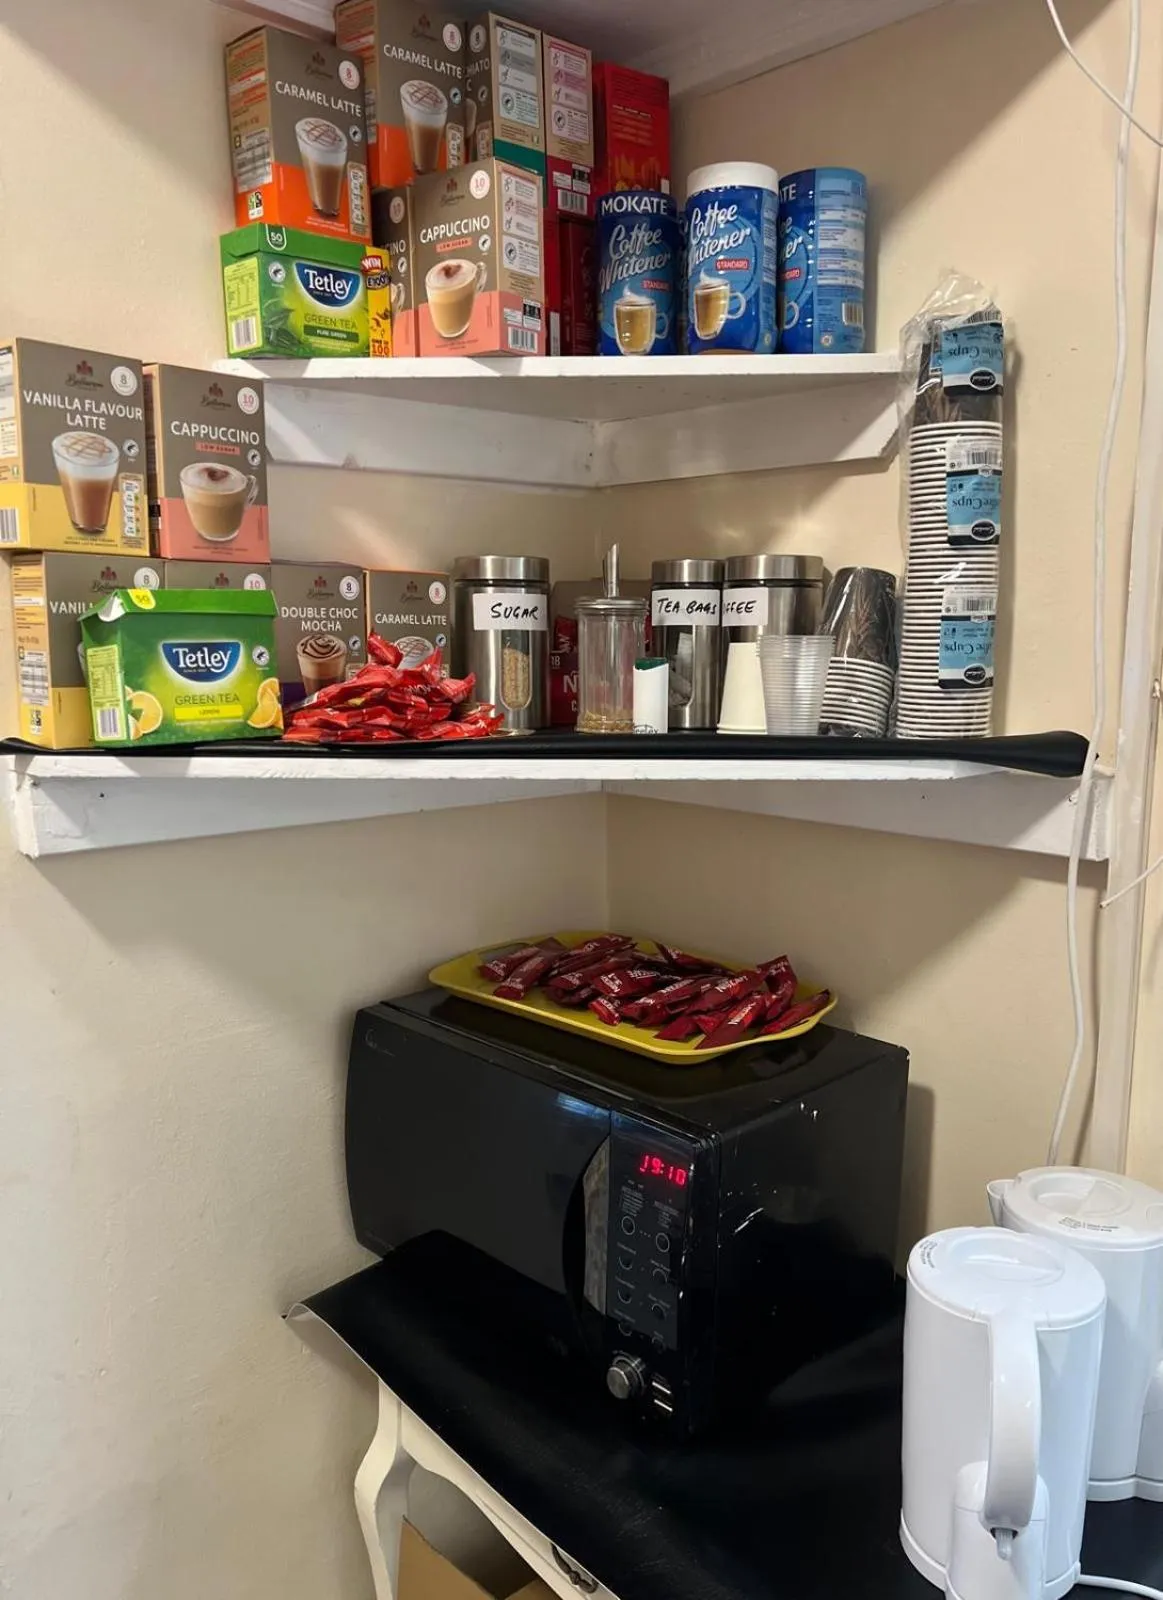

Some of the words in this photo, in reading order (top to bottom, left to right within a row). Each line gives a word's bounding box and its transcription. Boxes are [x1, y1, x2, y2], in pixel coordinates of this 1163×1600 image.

[383, 43, 433, 70] CARAMEL
[434, 59, 463, 79] LATTE
[275, 80, 329, 107] CARAMEL
[331, 97, 362, 118] LATTE
[474, 176, 486, 189] 10
[601, 195, 668, 216] MOKATE
[419, 214, 491, 244] CAPPUCCINO
[690, 200, 738, 245] Coffee
[270, 230, 283, 242] 50
[609, 223, 663, 260] Coffee
[361, 257, 382, 270] WIN
[599, 251, 671, 293] Whitener
[303, 268, 353, 300] Tetley
[303, 312, 337, 327] GREEN
[340, 318, 358, 331] TEA
[371, 343, 390, 354] 100
[947, 344, 981, 359] Cups
[120, 374, 127, 385] 8
[23, 389, 82, 411] VANILLA
[85, 399, 143, 421] FLAVOUR
[243, 393, 254, 405] 10
[66, 412, 107, 430] LATTE
[170, 420, 260, 446] CAPPUCCINO
[951, 495, 983, 510] Cups
[143, 574, 150, 585] 8
[50, 600, 94, 615] VANIL
[281, 606, 327, 619] DOUBLE
[329, 607, 359, 619] CHOC
[490, 602, 539, 621] SUGAR
[657, 597, 681, 615] TEA
[686, 599, 717, 615] BAGS
[301, 620, 342, 632] MOCHA
[374, 613, 420, 625] CARAMEL
[421, 615, 447, 626] LATTE
[944, 640, 975, 655] Cups
[172, 646, 232, 673] Tetley
[174, 693, 215, 706] GREEN
[216, 692, 240, 703] TEA
